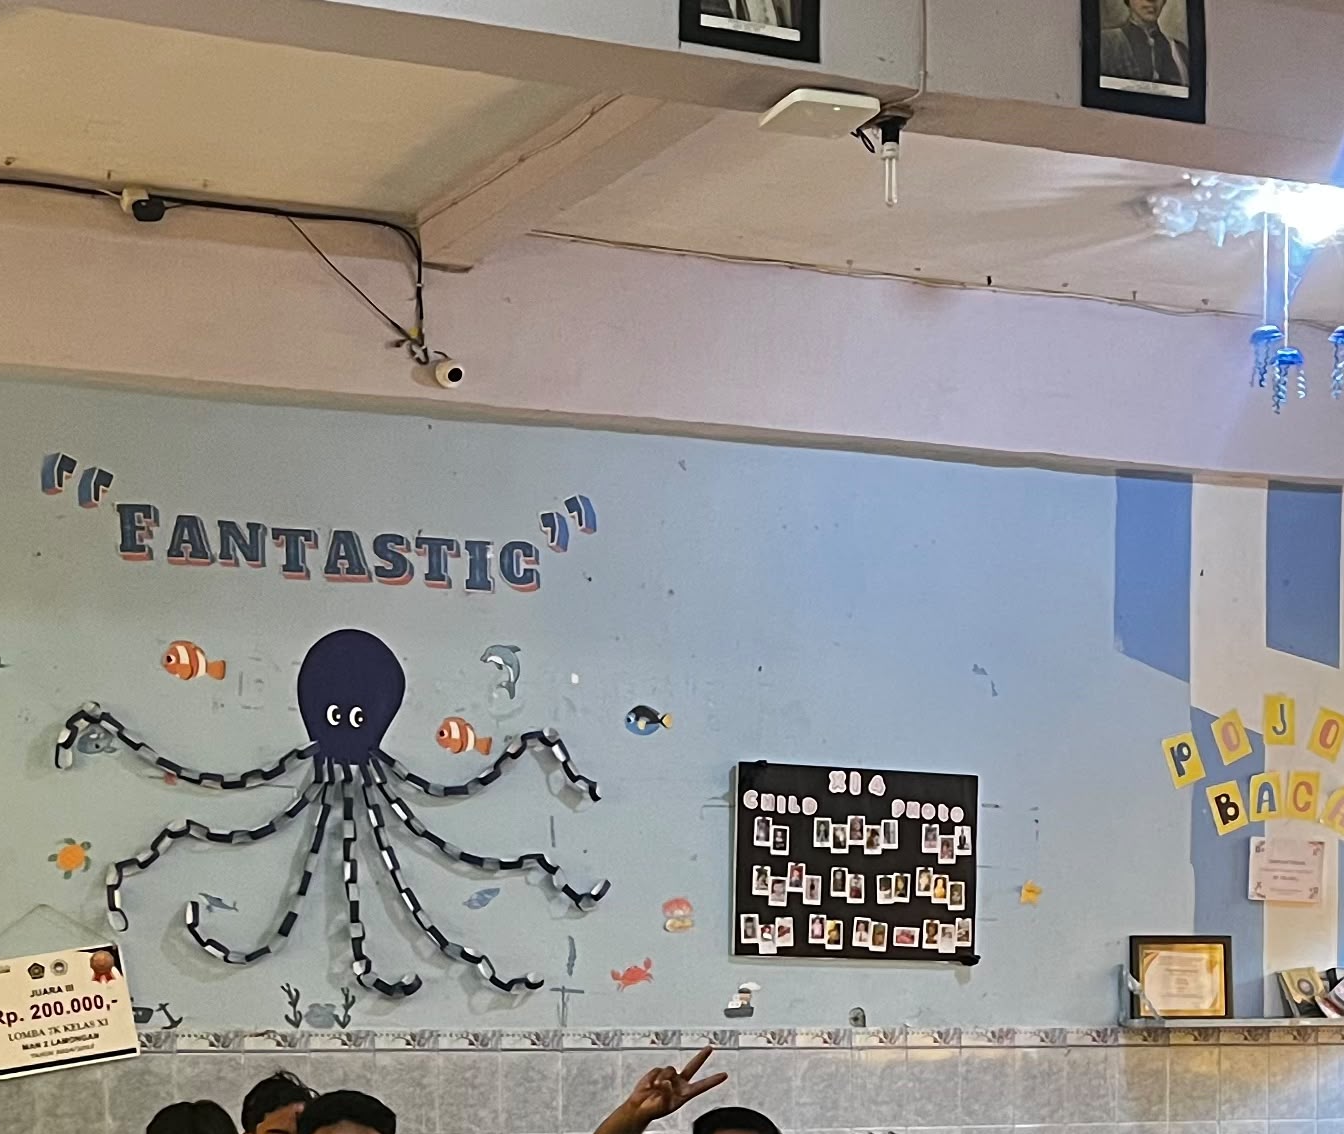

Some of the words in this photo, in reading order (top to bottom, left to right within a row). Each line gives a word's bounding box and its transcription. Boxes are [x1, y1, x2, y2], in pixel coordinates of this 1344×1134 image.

[828, 770, 862, 795] XI
[868, 774, 887, 796] 4
[743, 789, 818, 815] CHILD
[891, 798, 965, 823] PHOTO
[30, 986, 62, 998] JUARA
[30, 995, 117, 1019] 200.000,-
[8, 1028, 46, 1042] LOMBA
[63, 1019, 96, 1032] KELAS
